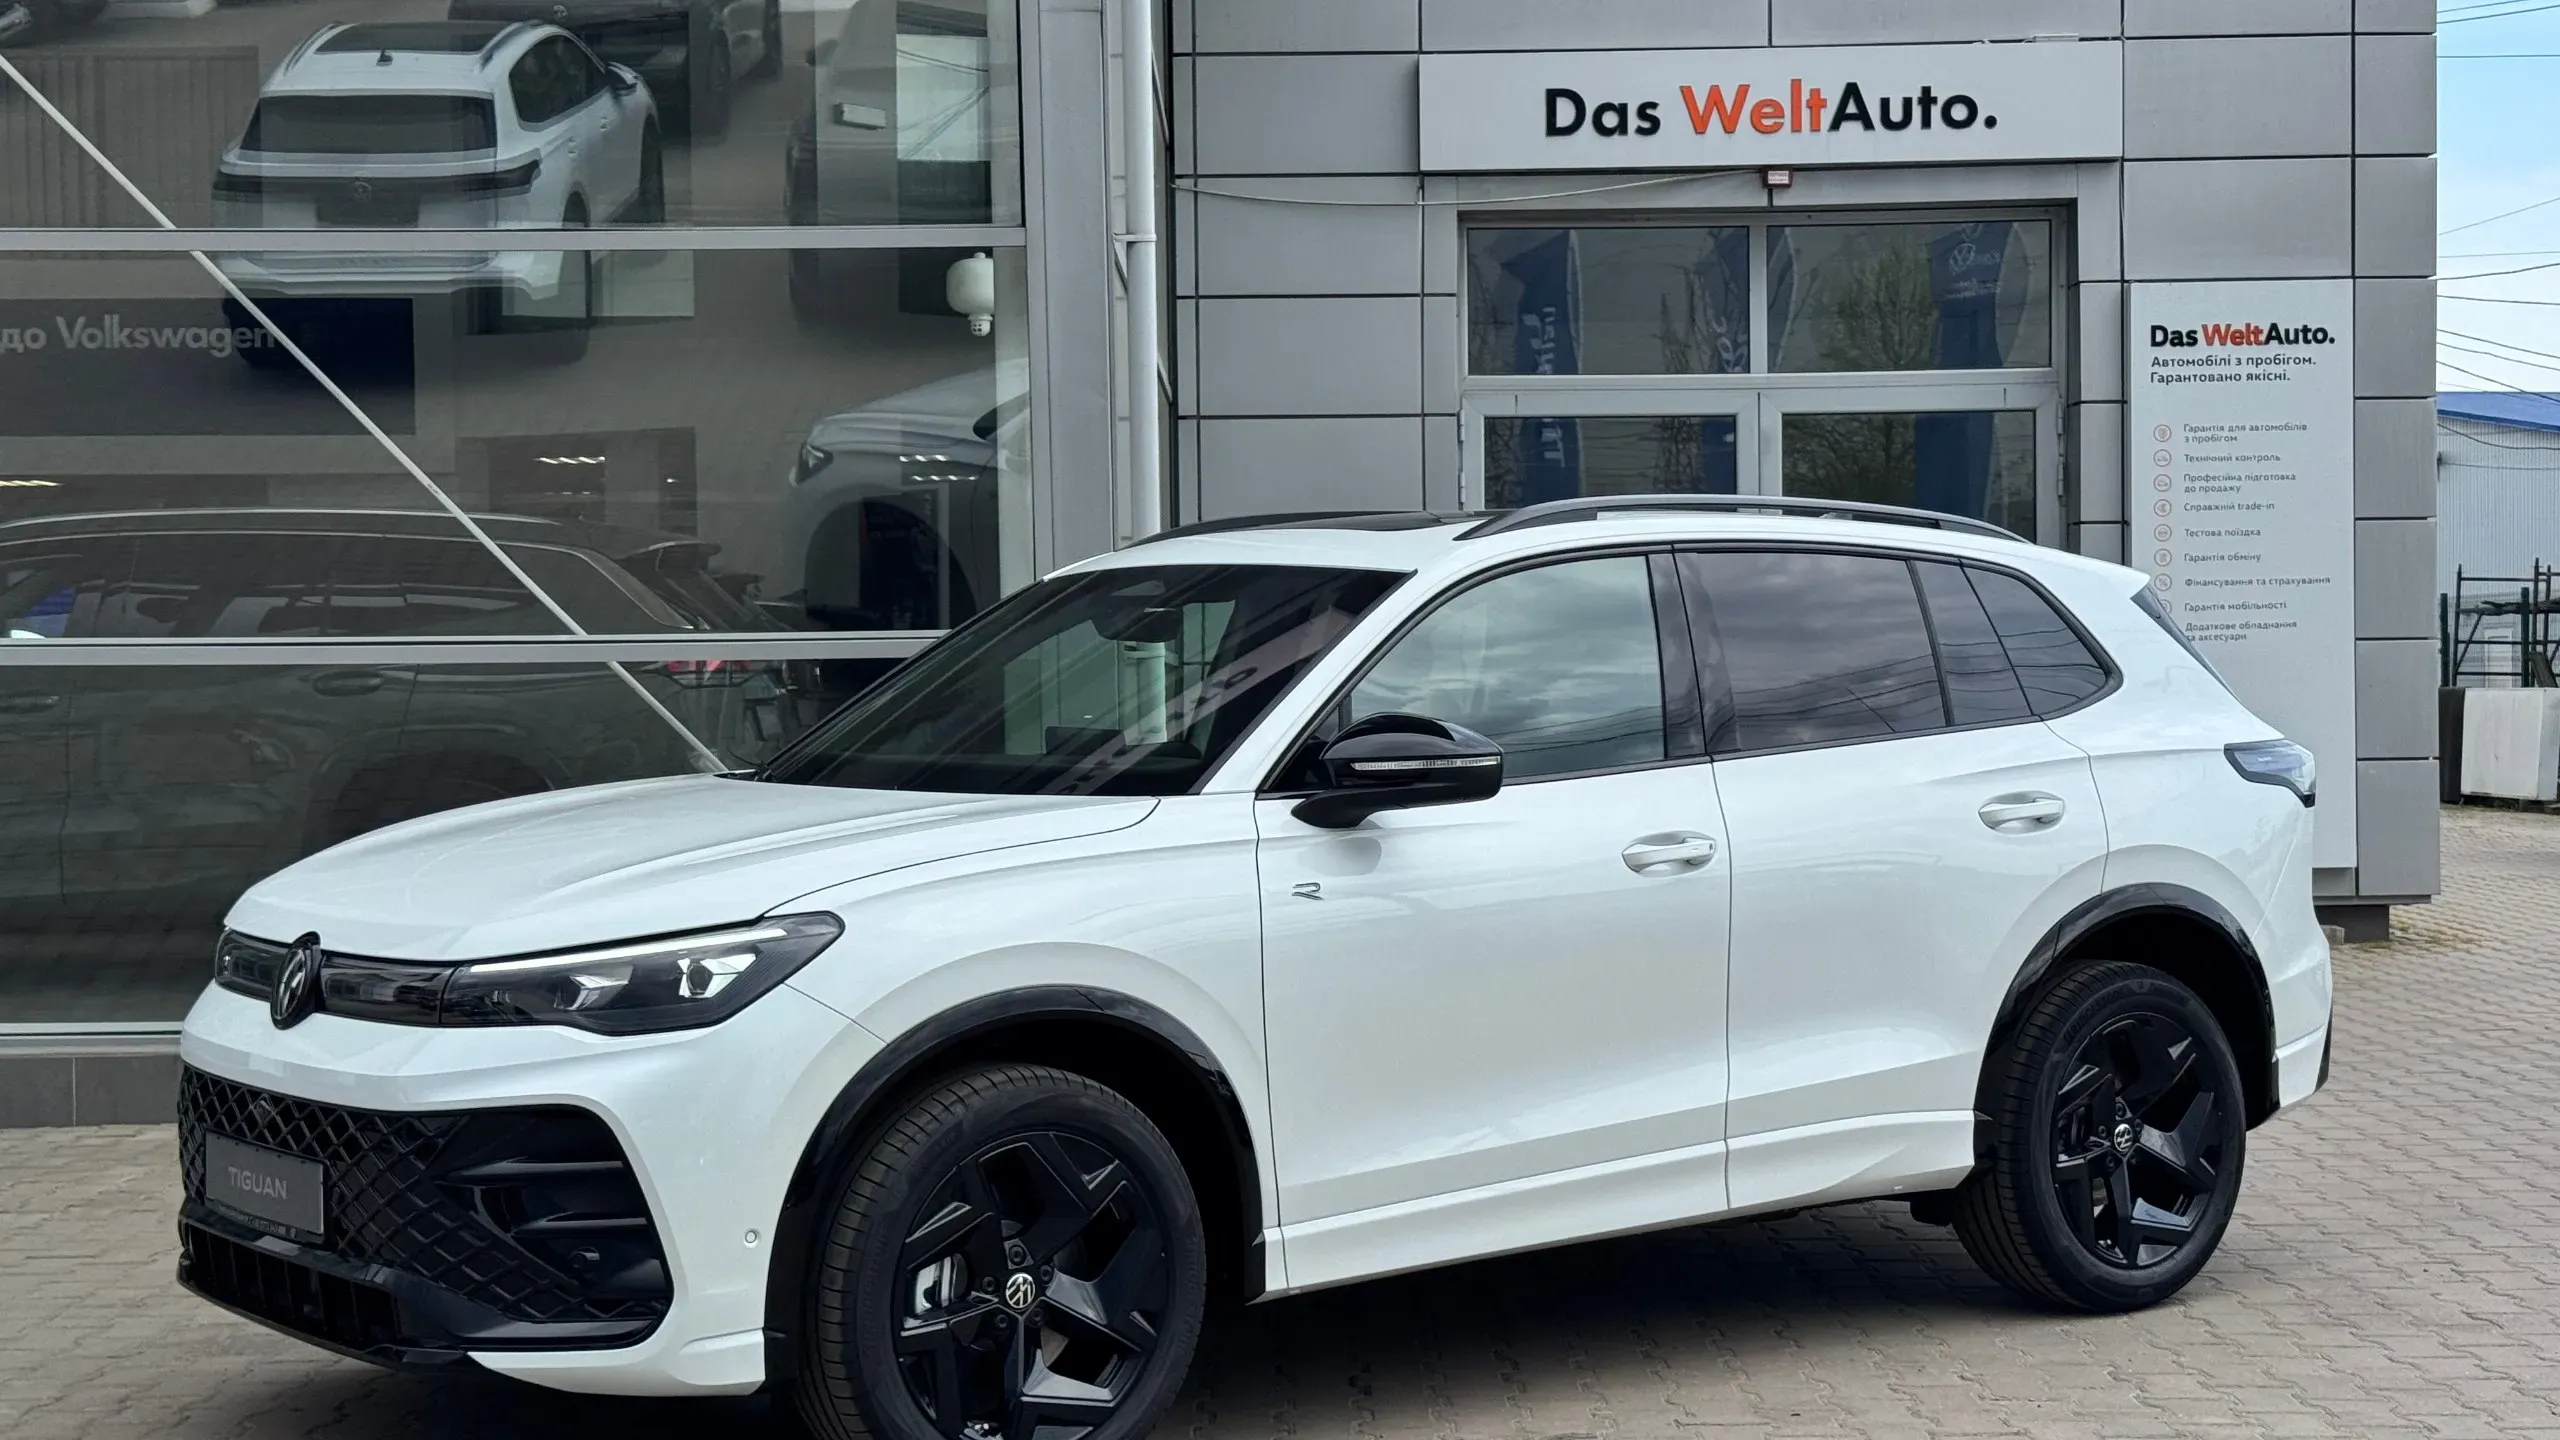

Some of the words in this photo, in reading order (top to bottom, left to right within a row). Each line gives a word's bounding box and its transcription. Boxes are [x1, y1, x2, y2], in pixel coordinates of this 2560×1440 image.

[1545, 87, 1661, 137] Das
[1679, 78, 1999, 134] WeltAuto.
[56, 313, 275, 358] Volkswagen
[2150, 324, 2198, 348] Das
[2201, 322, 2336, 346] WeltAuto.
[2151, 354, 2231, 368] Автомобілі
[2235, 356, 2242, 367] з
[2246, 353, 2316, 369] пробігом.
[2150, 371, 2242, 386] Гарантовано
[2245, 369, 2291, 382] якісні.
[2183, 423, 2225, 434] Гарантія
[2227, 424, 2246, 433] для
[2248, 421, 2308, 432] автомобілів
[2192, 433, 2238, 444] пробігом
[2184, 452, 2233, 463] Технічний
[2235, 454, 2281, 464] контроль
[2183, 472, 2242, 483] Професійна
[2244, 472, 2296, 482] підготовка
[2184, 484, 2197, 494] до
[2198, 484, 2242, 494] продажу
[2183, 501, 2235, 513] Справжній
[2237, 501, 2275, 511] trade-in
[2184, 528, 2222, 538] Тестова
[2224, 527, 2261, 538] поїздка
[2183, 553, 2226, 564] Гарантія
[2227, 553, 2262, 563] обміну
[2184, 578, 2253, 588] Фінансування
[2256, 578, 2267, 586] та
[2268, 576, 2331, 587] страхування
[2184, 602, 2226, 613] Гарантія
[2227, 601, 2287, 611] мобільності
[2185, 622, 2237, 633] Додаткове
[2238, 620, 2298, 630] обладнання
[2198, 633, 2247, 643] аксесуари
[228, 1166, 288, 1200] TIGUAN
